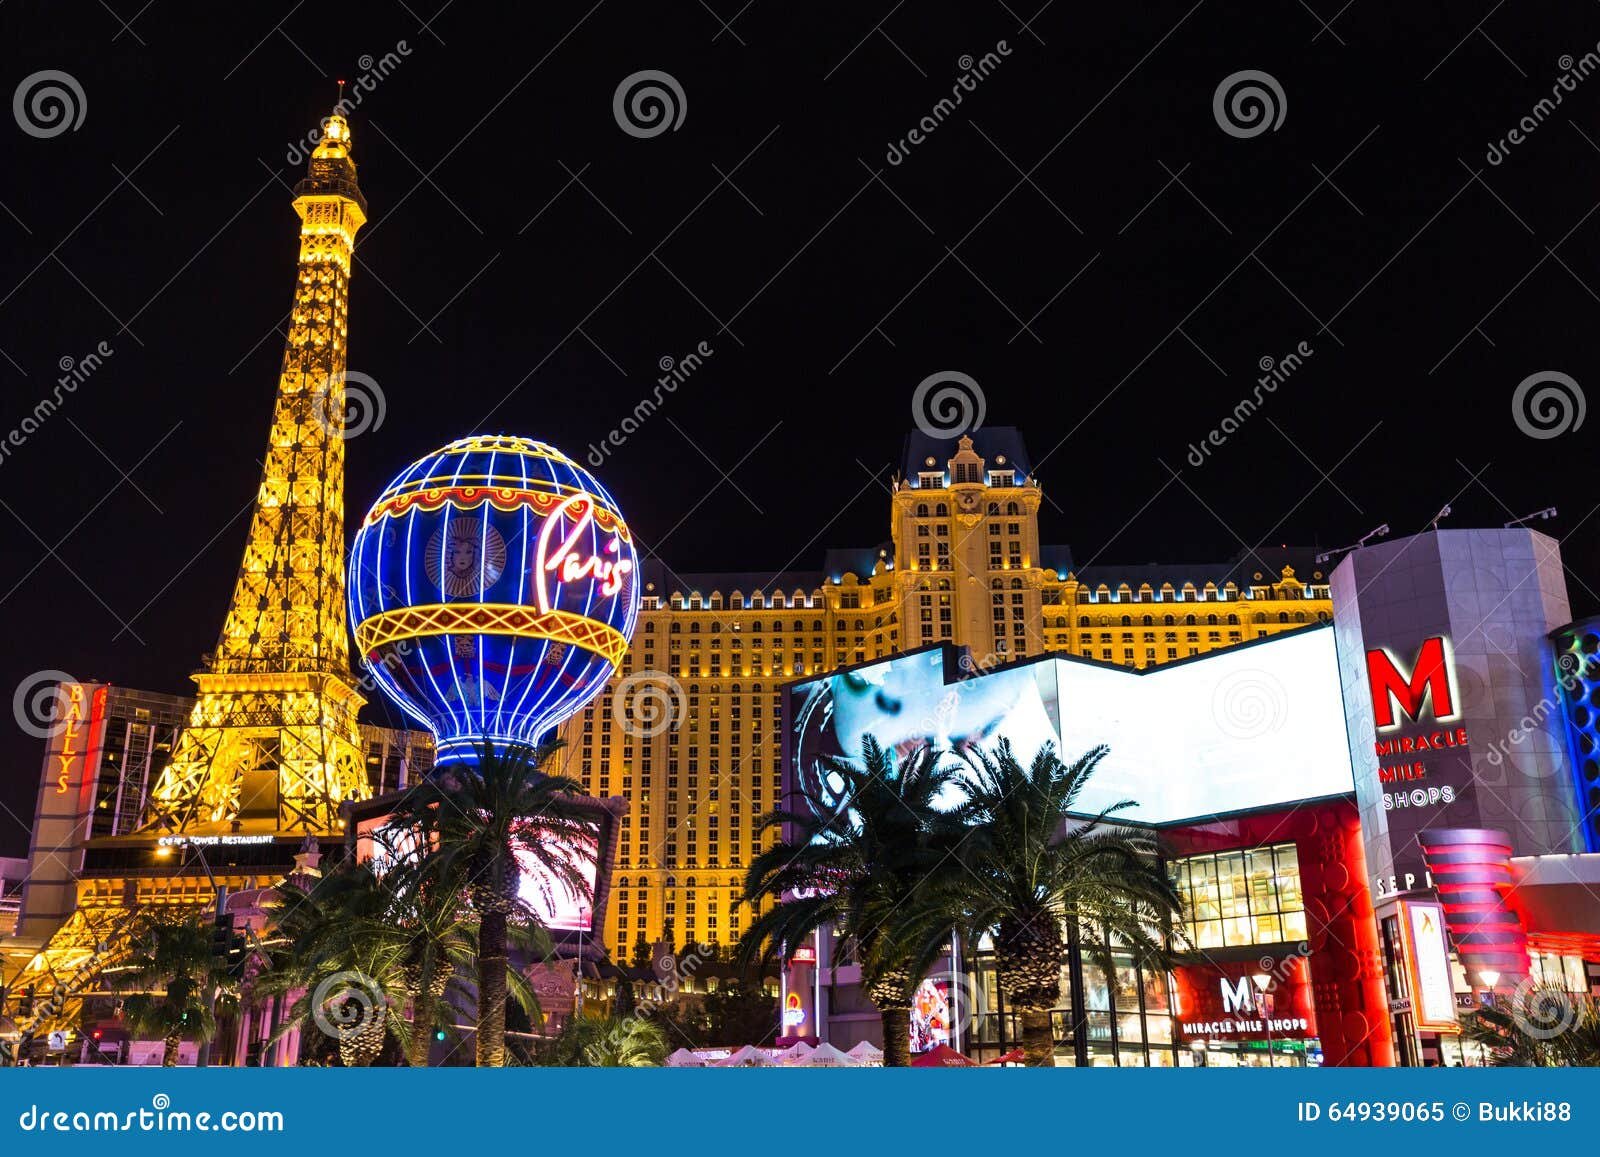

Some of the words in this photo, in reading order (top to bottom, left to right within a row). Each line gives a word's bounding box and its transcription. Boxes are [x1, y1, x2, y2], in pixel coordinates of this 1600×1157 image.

[533, 490, 633, 615] Paris
[1366, 635, 1461, 731] M
[1374, 728, 1469, 757] MIRACLE
[1378, 761, 1427, 784] MILE
[1383, 785, 1456, 810] SHOPS
[189, 836, 219, 845] TOWER
[221, 835, 274, 845] RESTAURANT
[1220, 975, 1255, 1013] M
[1183, 1021, 1233, 1035] MIRACLE
[1235, 1020, 1263, 1033] MILE
